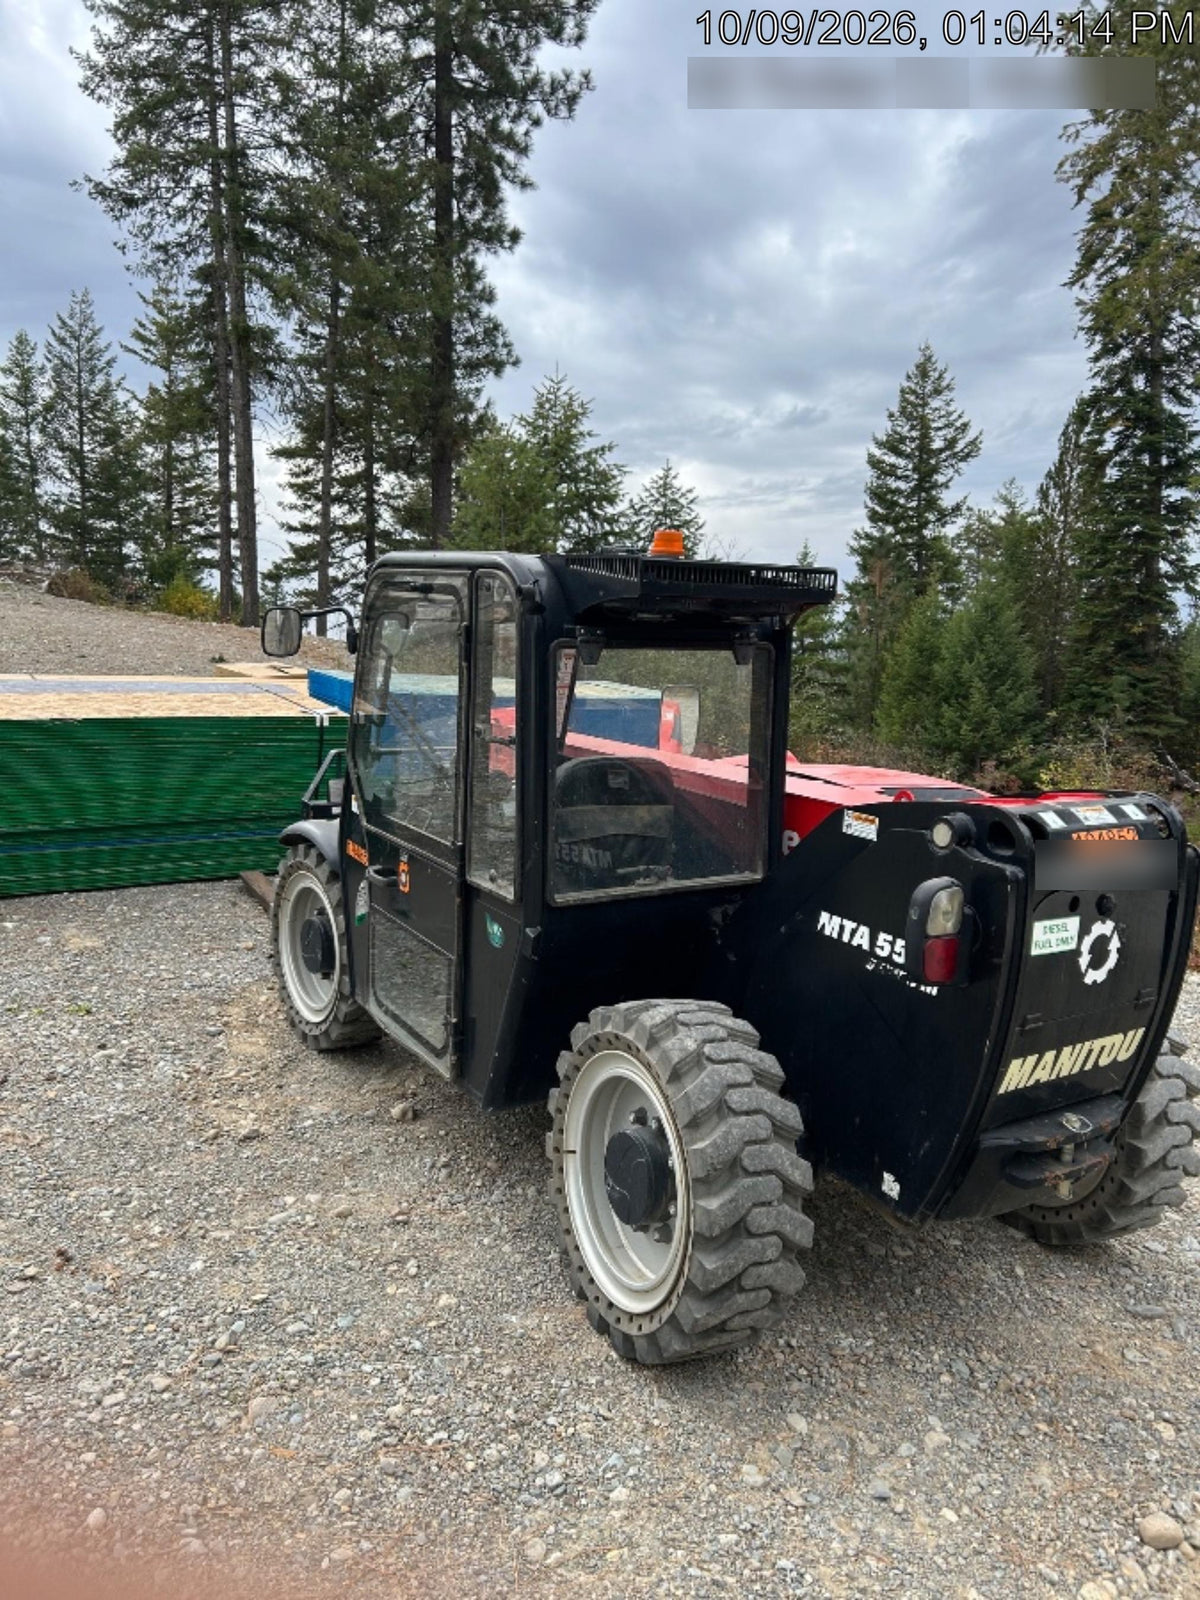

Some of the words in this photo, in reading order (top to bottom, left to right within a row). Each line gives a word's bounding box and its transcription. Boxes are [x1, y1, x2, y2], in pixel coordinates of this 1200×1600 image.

[817, 910, 871, 951] MTA
[1043, 922, 1070, 935] DIESEL
[1034, 938, 1053, 950] FUEL
[997, 1027, 1146, 1095] MANITOU
